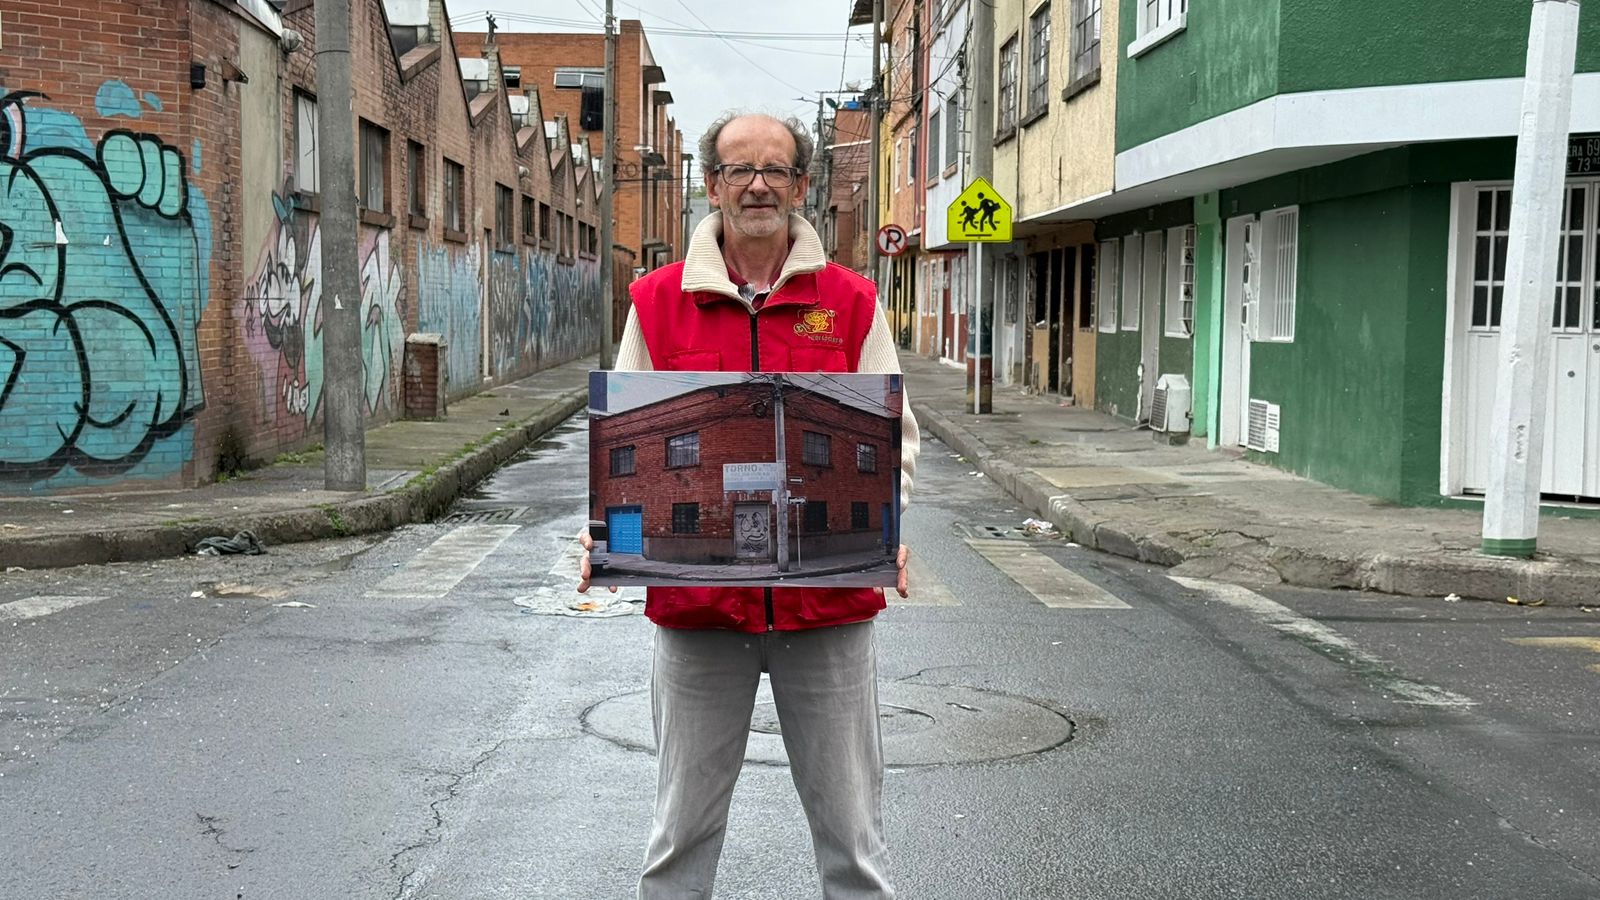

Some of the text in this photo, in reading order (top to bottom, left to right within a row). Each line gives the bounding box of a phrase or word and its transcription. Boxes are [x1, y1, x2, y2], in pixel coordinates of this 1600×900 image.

[1587, 138, 1600, 156] 69
[1578, 157, 1591, 172] 73
[885, 229, 902, 250] P
